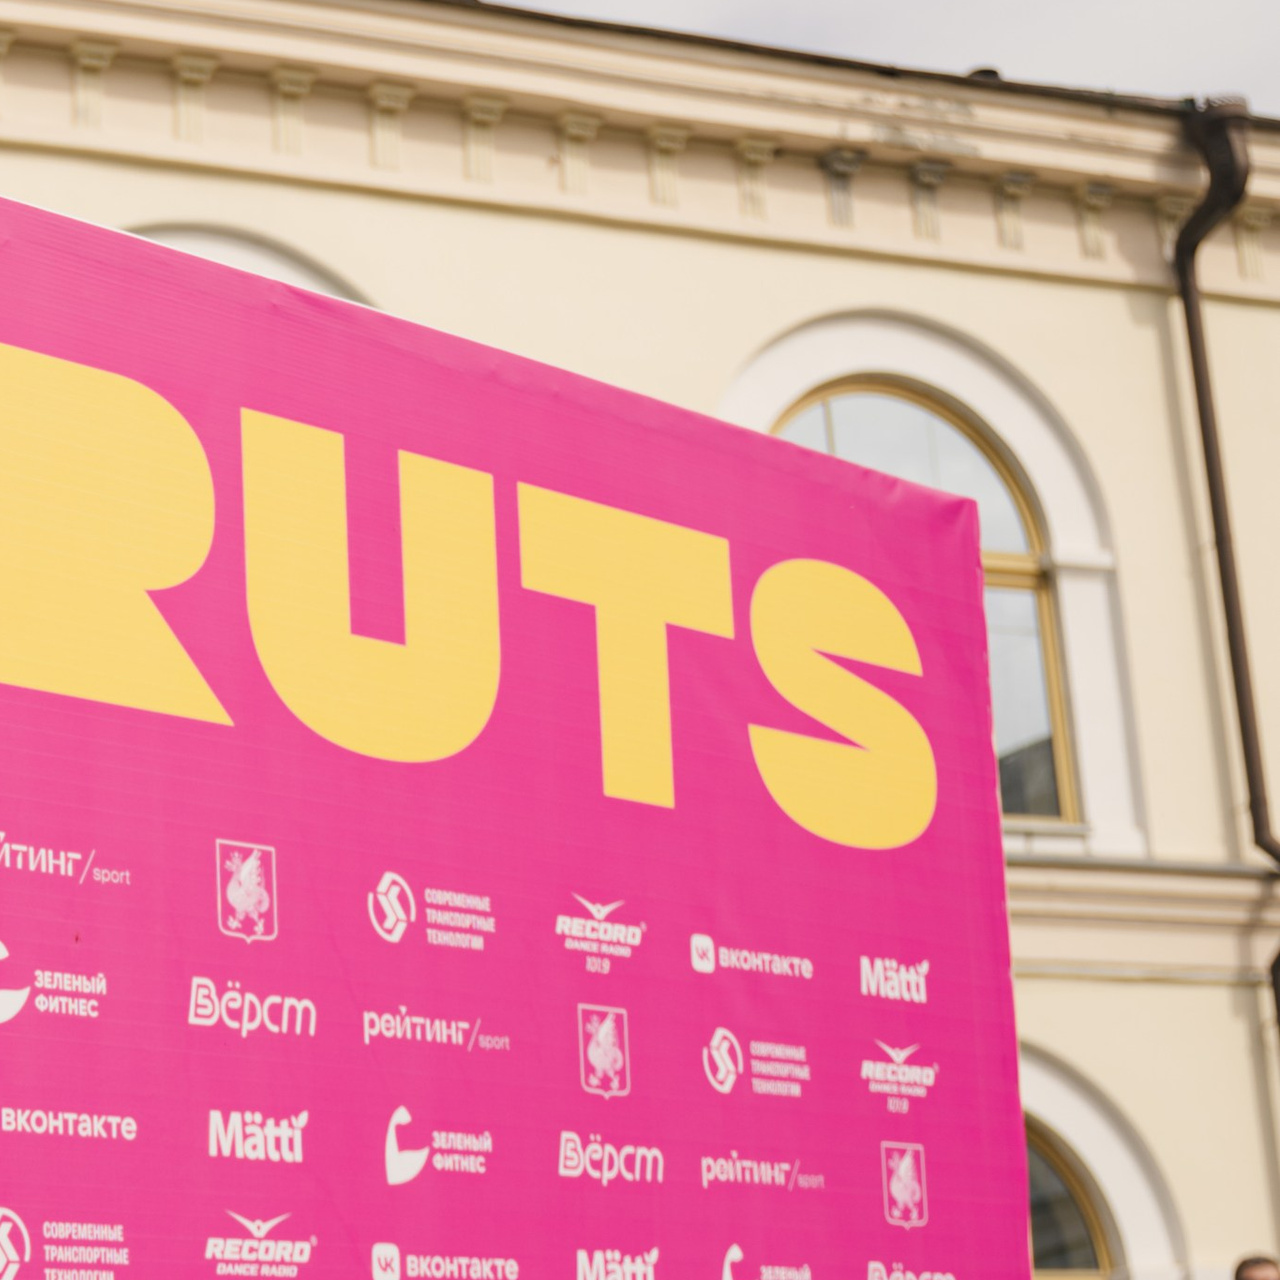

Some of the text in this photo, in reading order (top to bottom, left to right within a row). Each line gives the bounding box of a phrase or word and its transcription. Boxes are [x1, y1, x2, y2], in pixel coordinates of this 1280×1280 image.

[34, 970, 107, 995] ЗЕЛЕНЫЙ
[860, 955, 929, 1004] Mätti
[34, 994, 99, 1018] ФИТНЕС
[208, 1110, 309, 1163] Mätti
[432, 1131, 493, 1152] ЗЕЛЕНЫЙ
[432, 1152, 486, 1174] ФИТНЕС
[43, 1221, 124, 1242] СОВРЕМЕННЫЕ
[44, 1245, 129, 1265] ТРАНСПОРТНЫЕ
[205, 1234, 311, 1264] RECORD
[216, 1262, 298, 1278] DANCE RADIO
